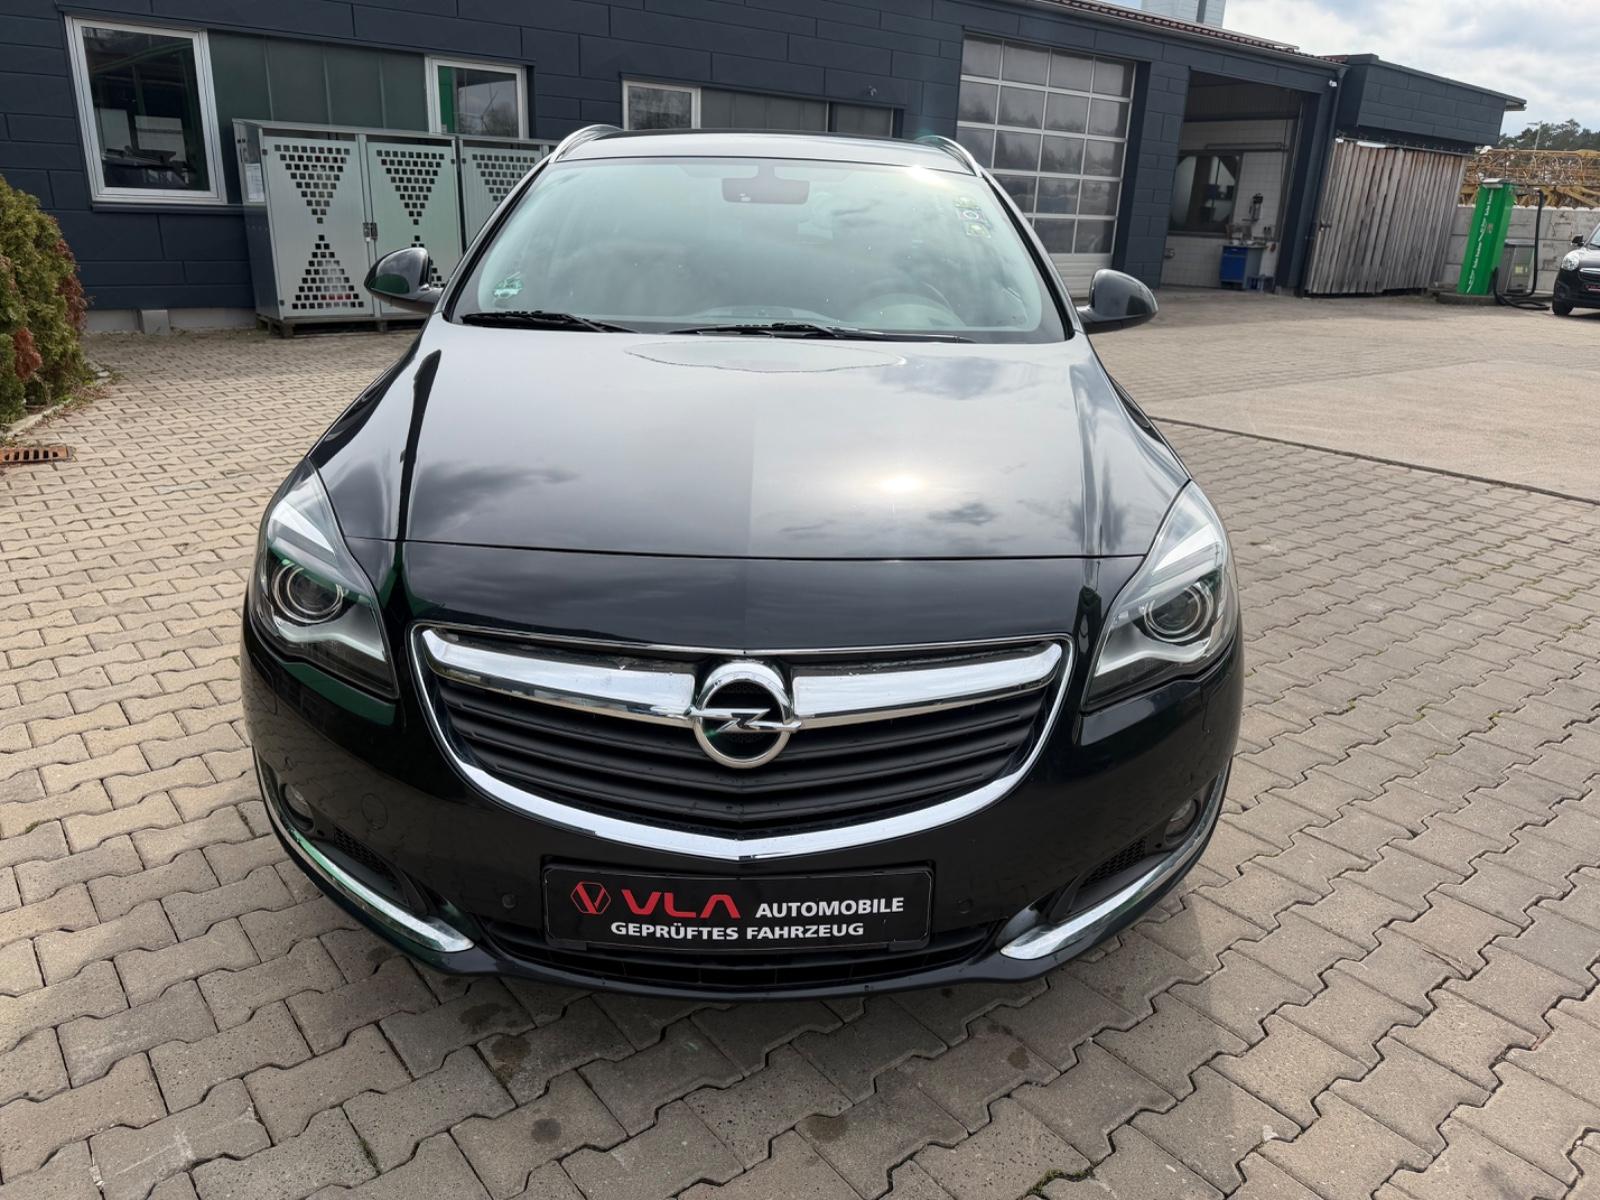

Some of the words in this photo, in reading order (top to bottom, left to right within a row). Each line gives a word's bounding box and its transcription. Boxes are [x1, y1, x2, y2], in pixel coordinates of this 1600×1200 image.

[621, 889, 741, 919] VLA
[755, 897, 904, 919] AUTOMOBILE
[611, 922, 739, 940] GEPRÜFTES
[746, 923, 864, 940] FAHRZEUG
